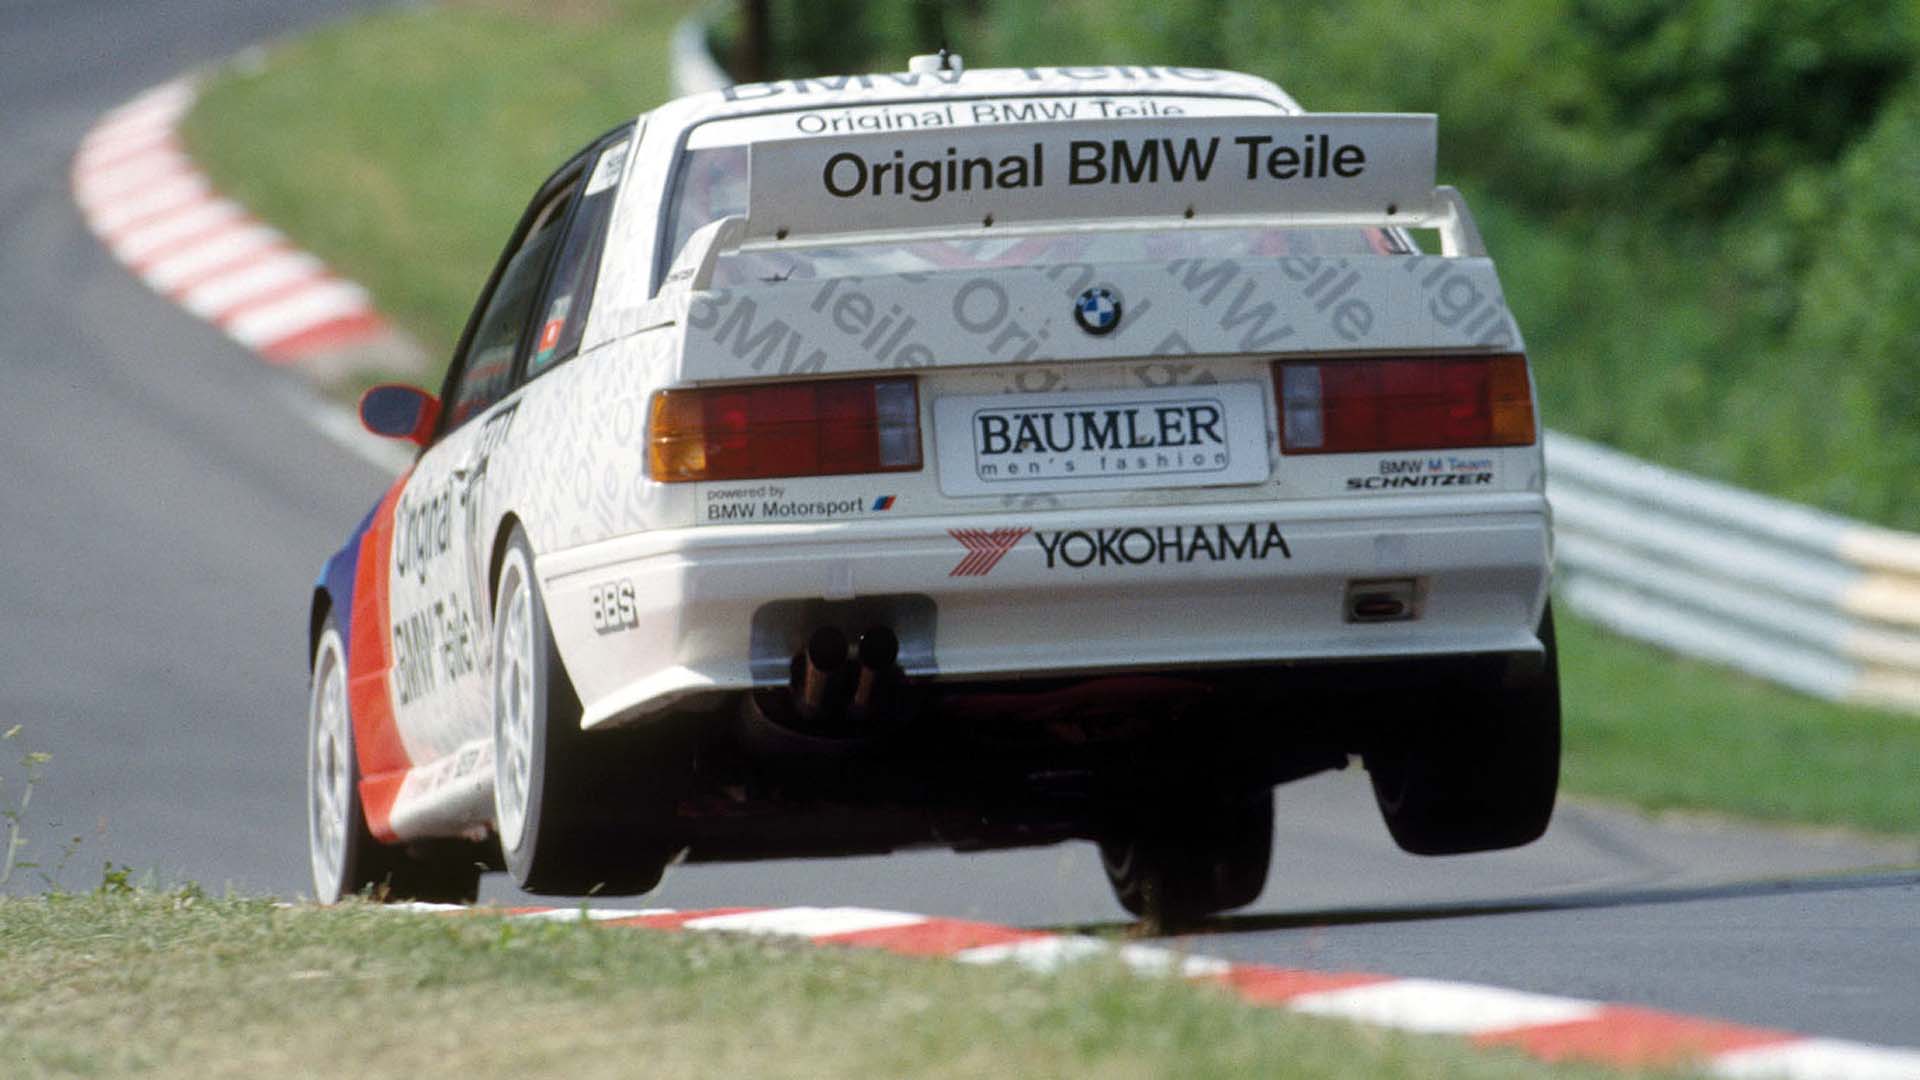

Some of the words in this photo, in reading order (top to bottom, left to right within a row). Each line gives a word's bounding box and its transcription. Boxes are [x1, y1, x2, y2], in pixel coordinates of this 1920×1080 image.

[796, 105, 955, 135] Original
[972, 101, 1077, 124] BMW
[822, 142, 1043, 202] Original
[1068, 137, 1220, 186] BMW
[1235, 134, 1366, 180] Teile
[979, 405, 1222, 455] BÄUMLER
[981, 456, 1075, 476] men's
[1100, 450, 1227, 471] fashion
[1380, 458, 1423, 475] BMW
[1448, 456, 1493, 471] Team
[707, 486, 765, 501] powered
[769, 483, 786, 499] by
[1346, 472, 1493, 491] SCHNITZER
[707, 501, 757, 521] BMW
[762, 496, 864, 517] Motorsport
[396, 480, 453, 587] Original
[1035, 522, 1291, 569] YOKOHAMA
[589, 579, 639, 635] BBS
